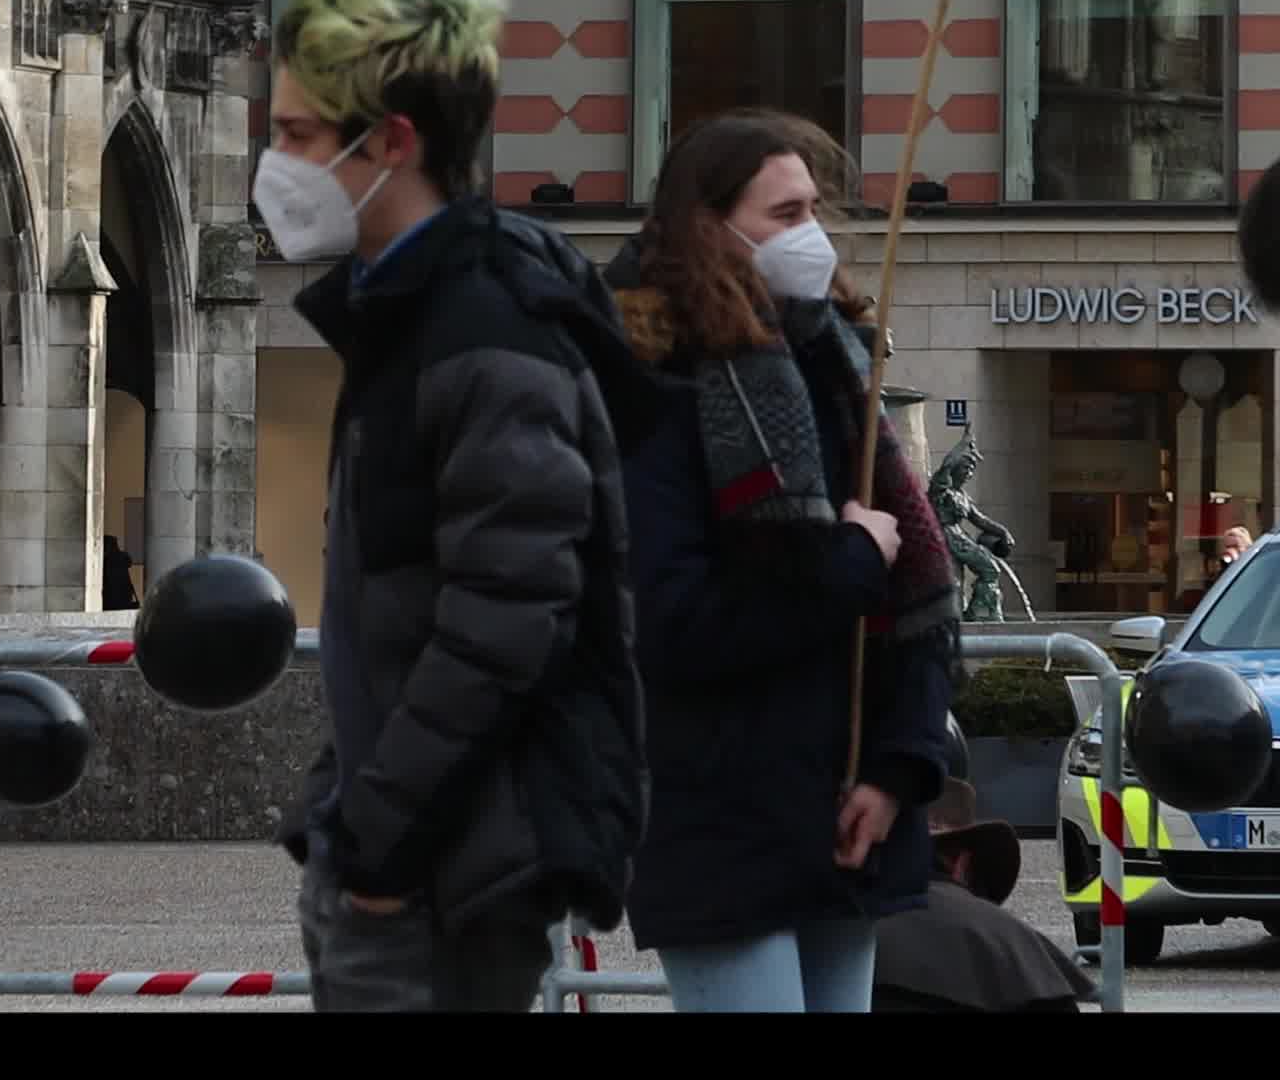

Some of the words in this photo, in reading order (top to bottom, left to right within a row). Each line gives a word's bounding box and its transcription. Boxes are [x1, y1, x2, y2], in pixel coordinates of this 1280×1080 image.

[991, 287, 1145, 324] LUDWIG
[1157, 287, 1257, 324] BECK
[951, 402, 962, 414] 11
[1248, 819, 1265, 845] M
